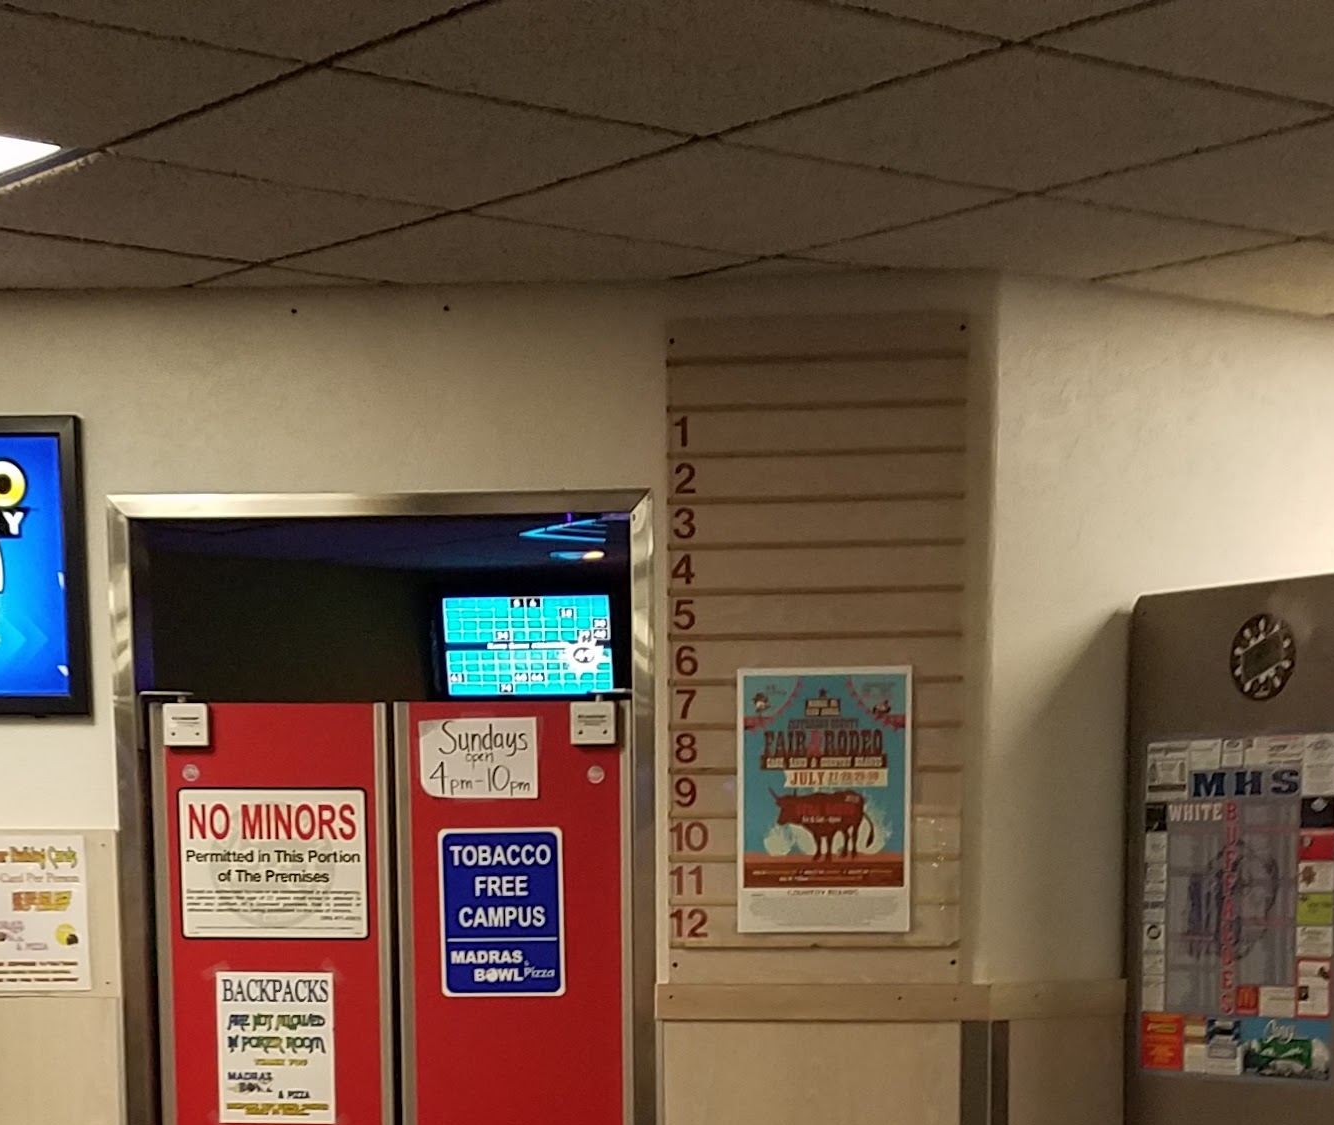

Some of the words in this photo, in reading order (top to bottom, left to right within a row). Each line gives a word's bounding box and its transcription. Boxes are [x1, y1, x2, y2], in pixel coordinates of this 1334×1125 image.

[674, 416, 690, 446] 1
[674, 462, 696, 494] 2
[673, 508, 696, 539] 3
[671, 555, 695, 584] 4
[673, 600, 696, 630] 5
[675, 645, 698, 676] 6
[675, 690, 696, 719] 7
[438, 720, 529, 757] Sundays
[675, 733, 698, 763] 8
[764, 730, 807, 756] FAIR
[824, 729, 883, 755] RODEO
[465, 751, 494, 769] open
[790, 771, 825, 785] JULY
[1193, 769, 1299, 797] MHS
[674, 777, 697, 808] 9
[188, 803, 230, 840] NO
[241, 803, 356, 840] MINORS
[1168, 802, 1223, 822] WHITE
[669, 821, 708, 852] 10
[186, 850, 254, 863] Permitted
[258, 850, 270, 863] in
[274, 850, 304, 863] This
[308, 850, 361, 863] Portion
[449, 844, 552, 867] TOBACCO
[218, 869, 232, 882] of
[235, 869, 261, 882] The
[265, 869, 330, 883] Premises
[474, 876, 529, 897] FREE
[669, 866, 704, 896] 11
[458, 906, 546, 928] CAMPUS
[669, 909, 708, 938] 12
[450, 950, 524, 964] MADRAS
[473, 968, 524, 983] BOWL
[523, 966, 556, 979] Pizza
[222, 979, 329, 1003] BACKPACKS
[252, 1012, 274, 1032] NOT
[241, 1036, 286, 1054] POKER
[286, 1036, 326, 1054] ROOM
[228, 1071, 273, 1081] MADRAS
